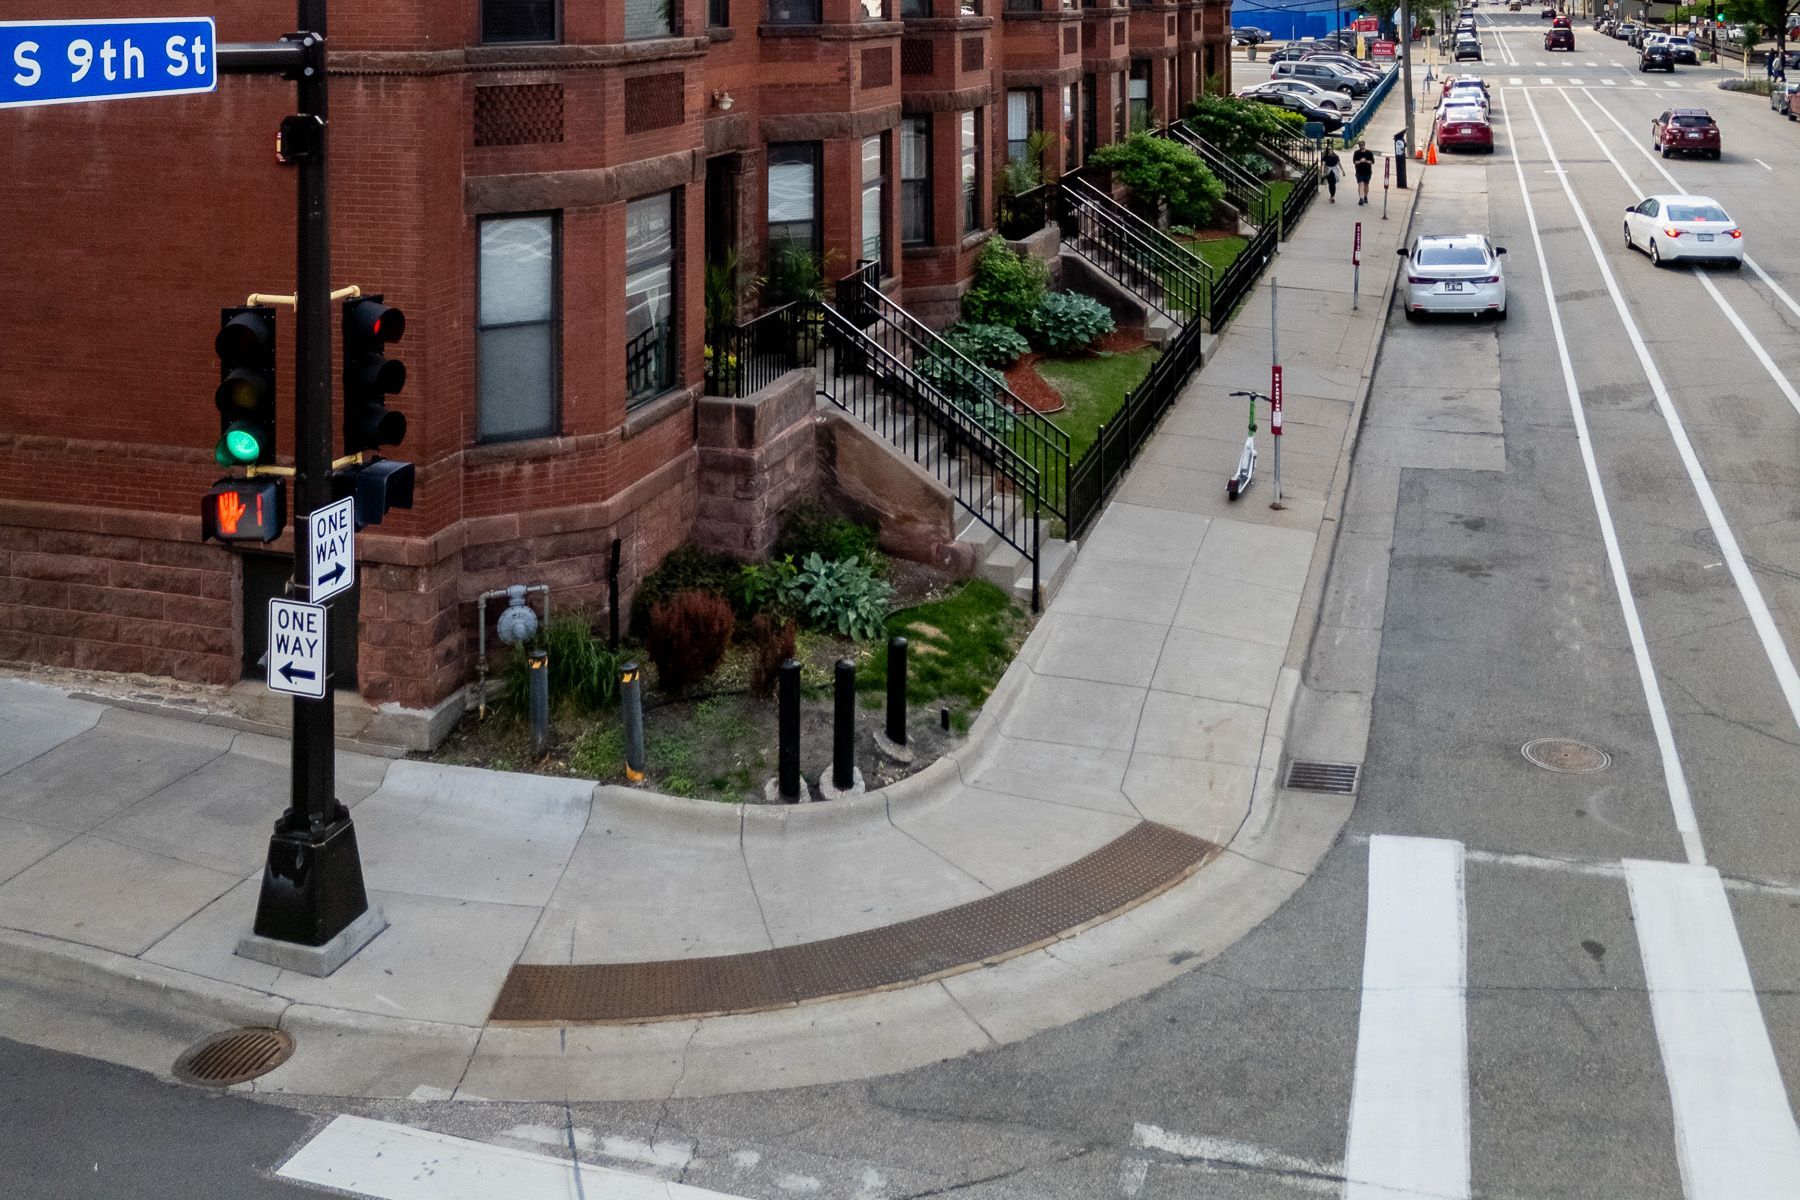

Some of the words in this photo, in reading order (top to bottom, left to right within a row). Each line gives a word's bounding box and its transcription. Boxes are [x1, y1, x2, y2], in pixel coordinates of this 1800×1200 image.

[13, 40, 42, 87] S
[67, 38, 145, 83] 9th
[165, 35, 206, 77] St
[317, 508, 348, 539] ONE
[315, 532, 348, 564] WAY
[277, 608, 318, 633] ONE
[275, 633, 318, 658] WAY
